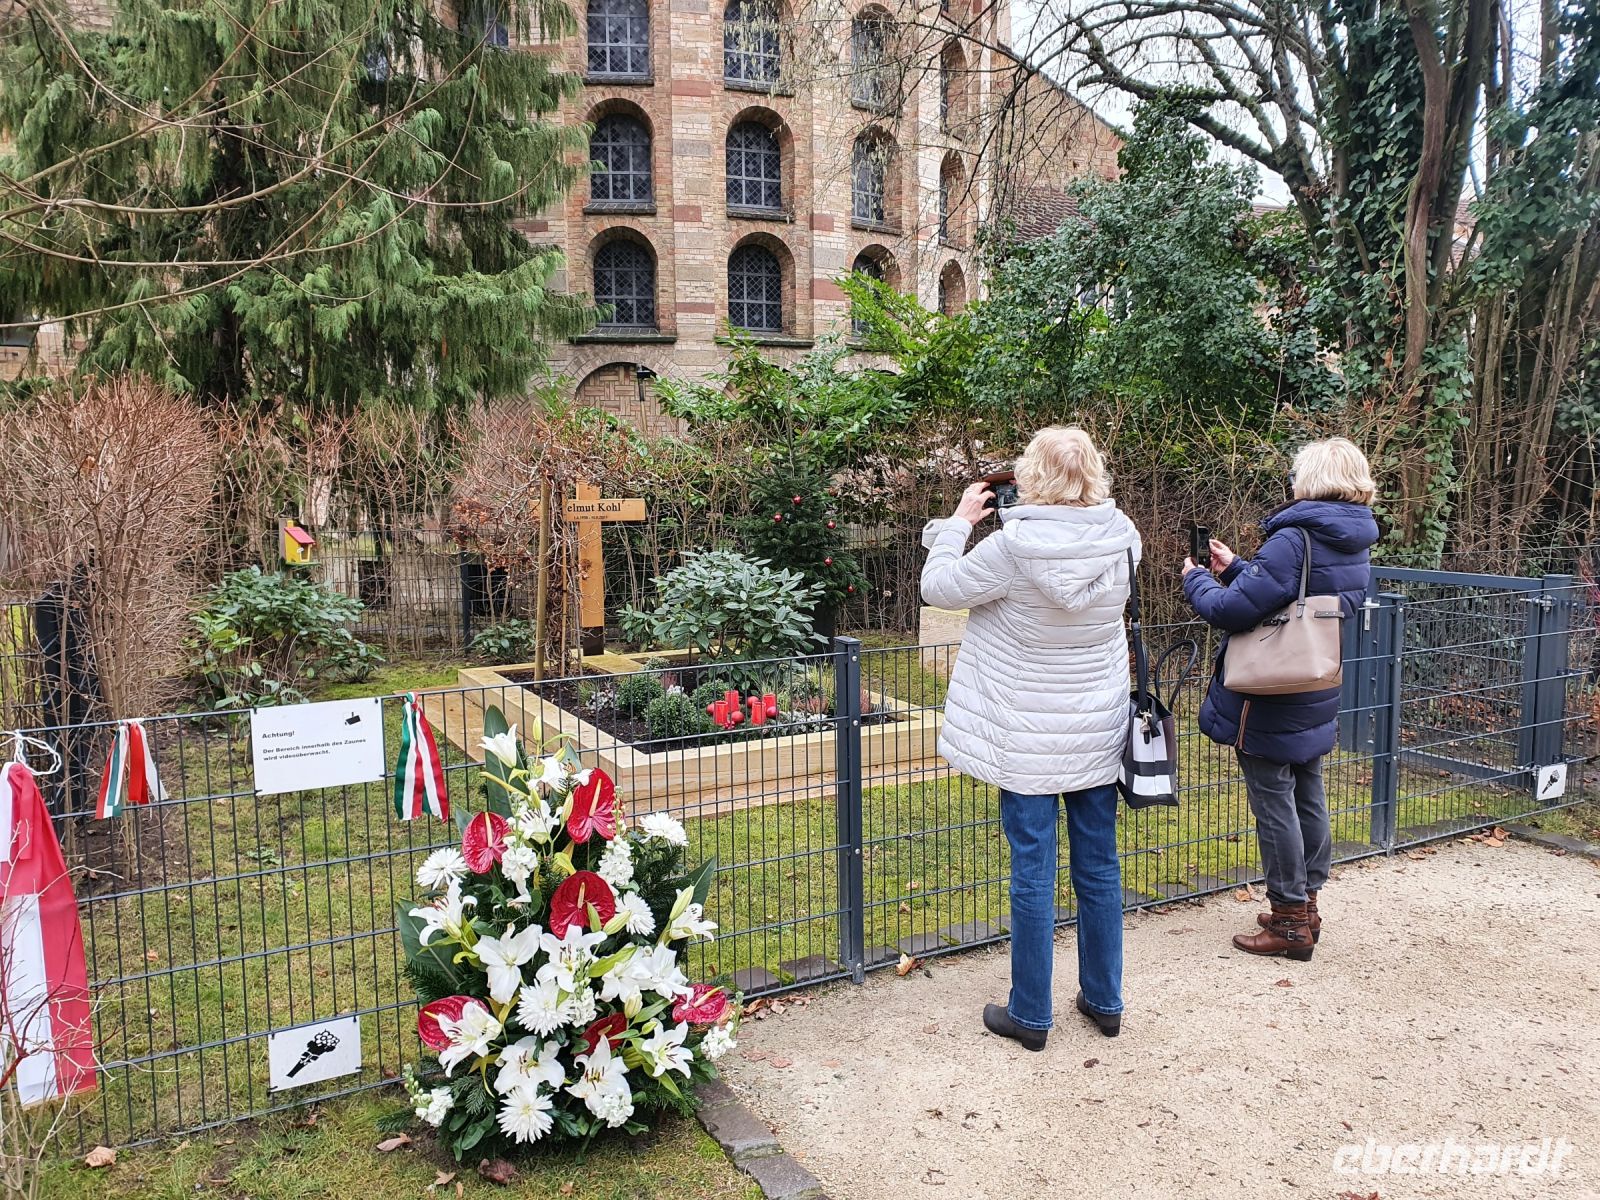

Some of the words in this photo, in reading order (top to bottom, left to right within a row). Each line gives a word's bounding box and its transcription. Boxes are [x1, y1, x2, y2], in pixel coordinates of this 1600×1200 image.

[566, 502, 595, 513] elmut
[597, 502, 621, 512] Kohl
[262, 730, 295, 739] Achtung!
[275, 745, 301, 753] Bereich
[301, 742, 331, 750] innerhalb
